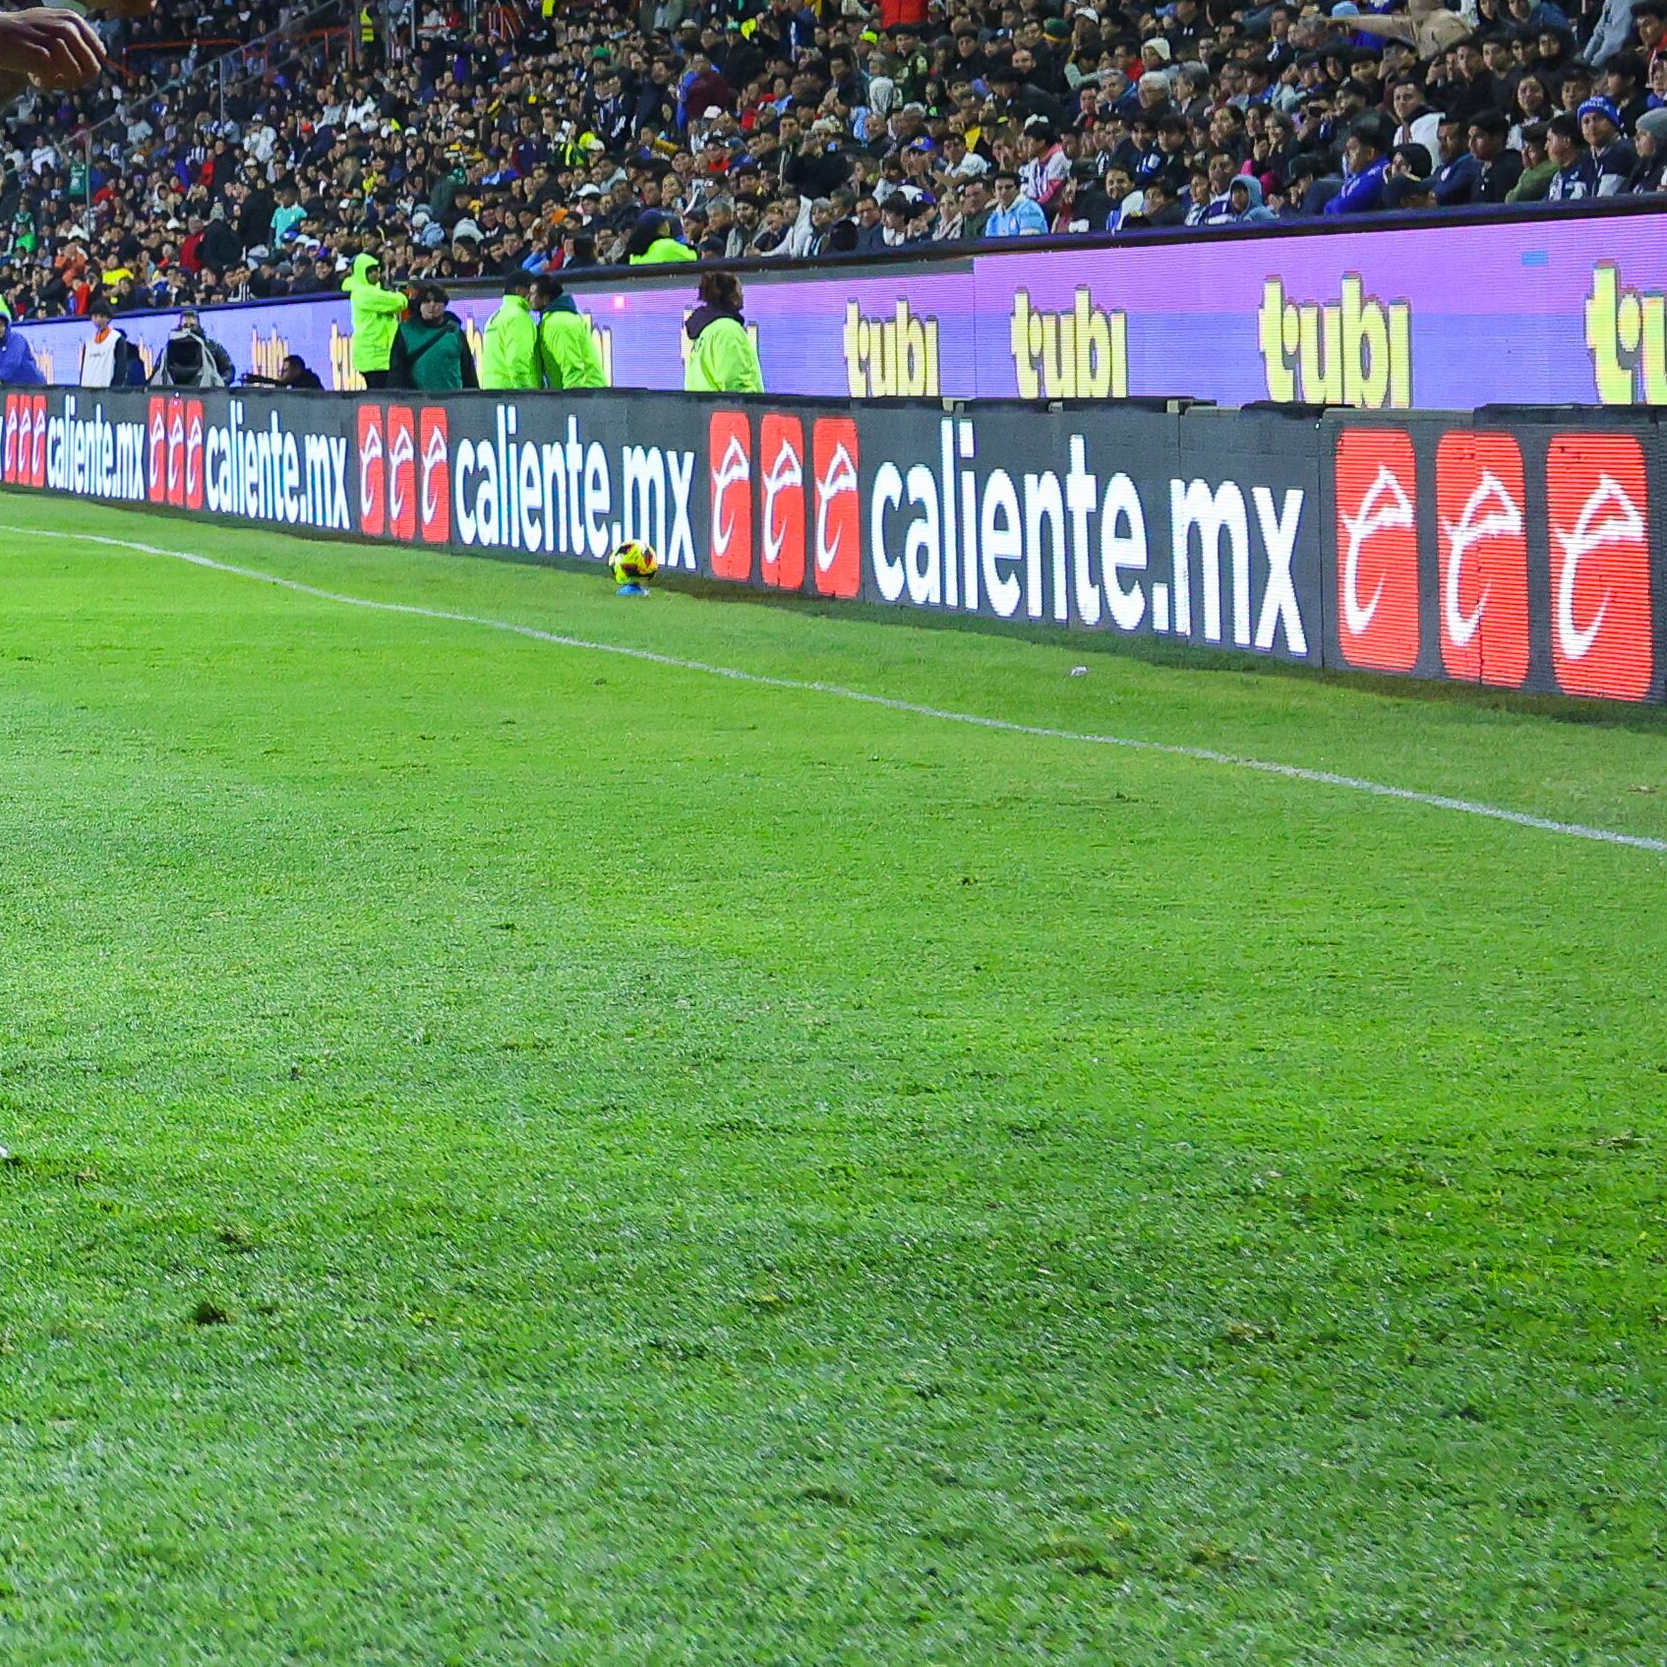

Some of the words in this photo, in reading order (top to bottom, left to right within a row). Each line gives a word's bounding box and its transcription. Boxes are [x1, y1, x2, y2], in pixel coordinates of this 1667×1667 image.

[843, 296, 939, 398] tubi
[1010, 284, 1128, 398] tubi
[1258, 271, 1413, 408] tubi
[46, 395, 145, 500] caliente.mx
[206, 399, 350, 530] caliente.mx
[455, 404, 697, 571] caliente.mx
[870, 416, 1309, 657] caliente.mx
